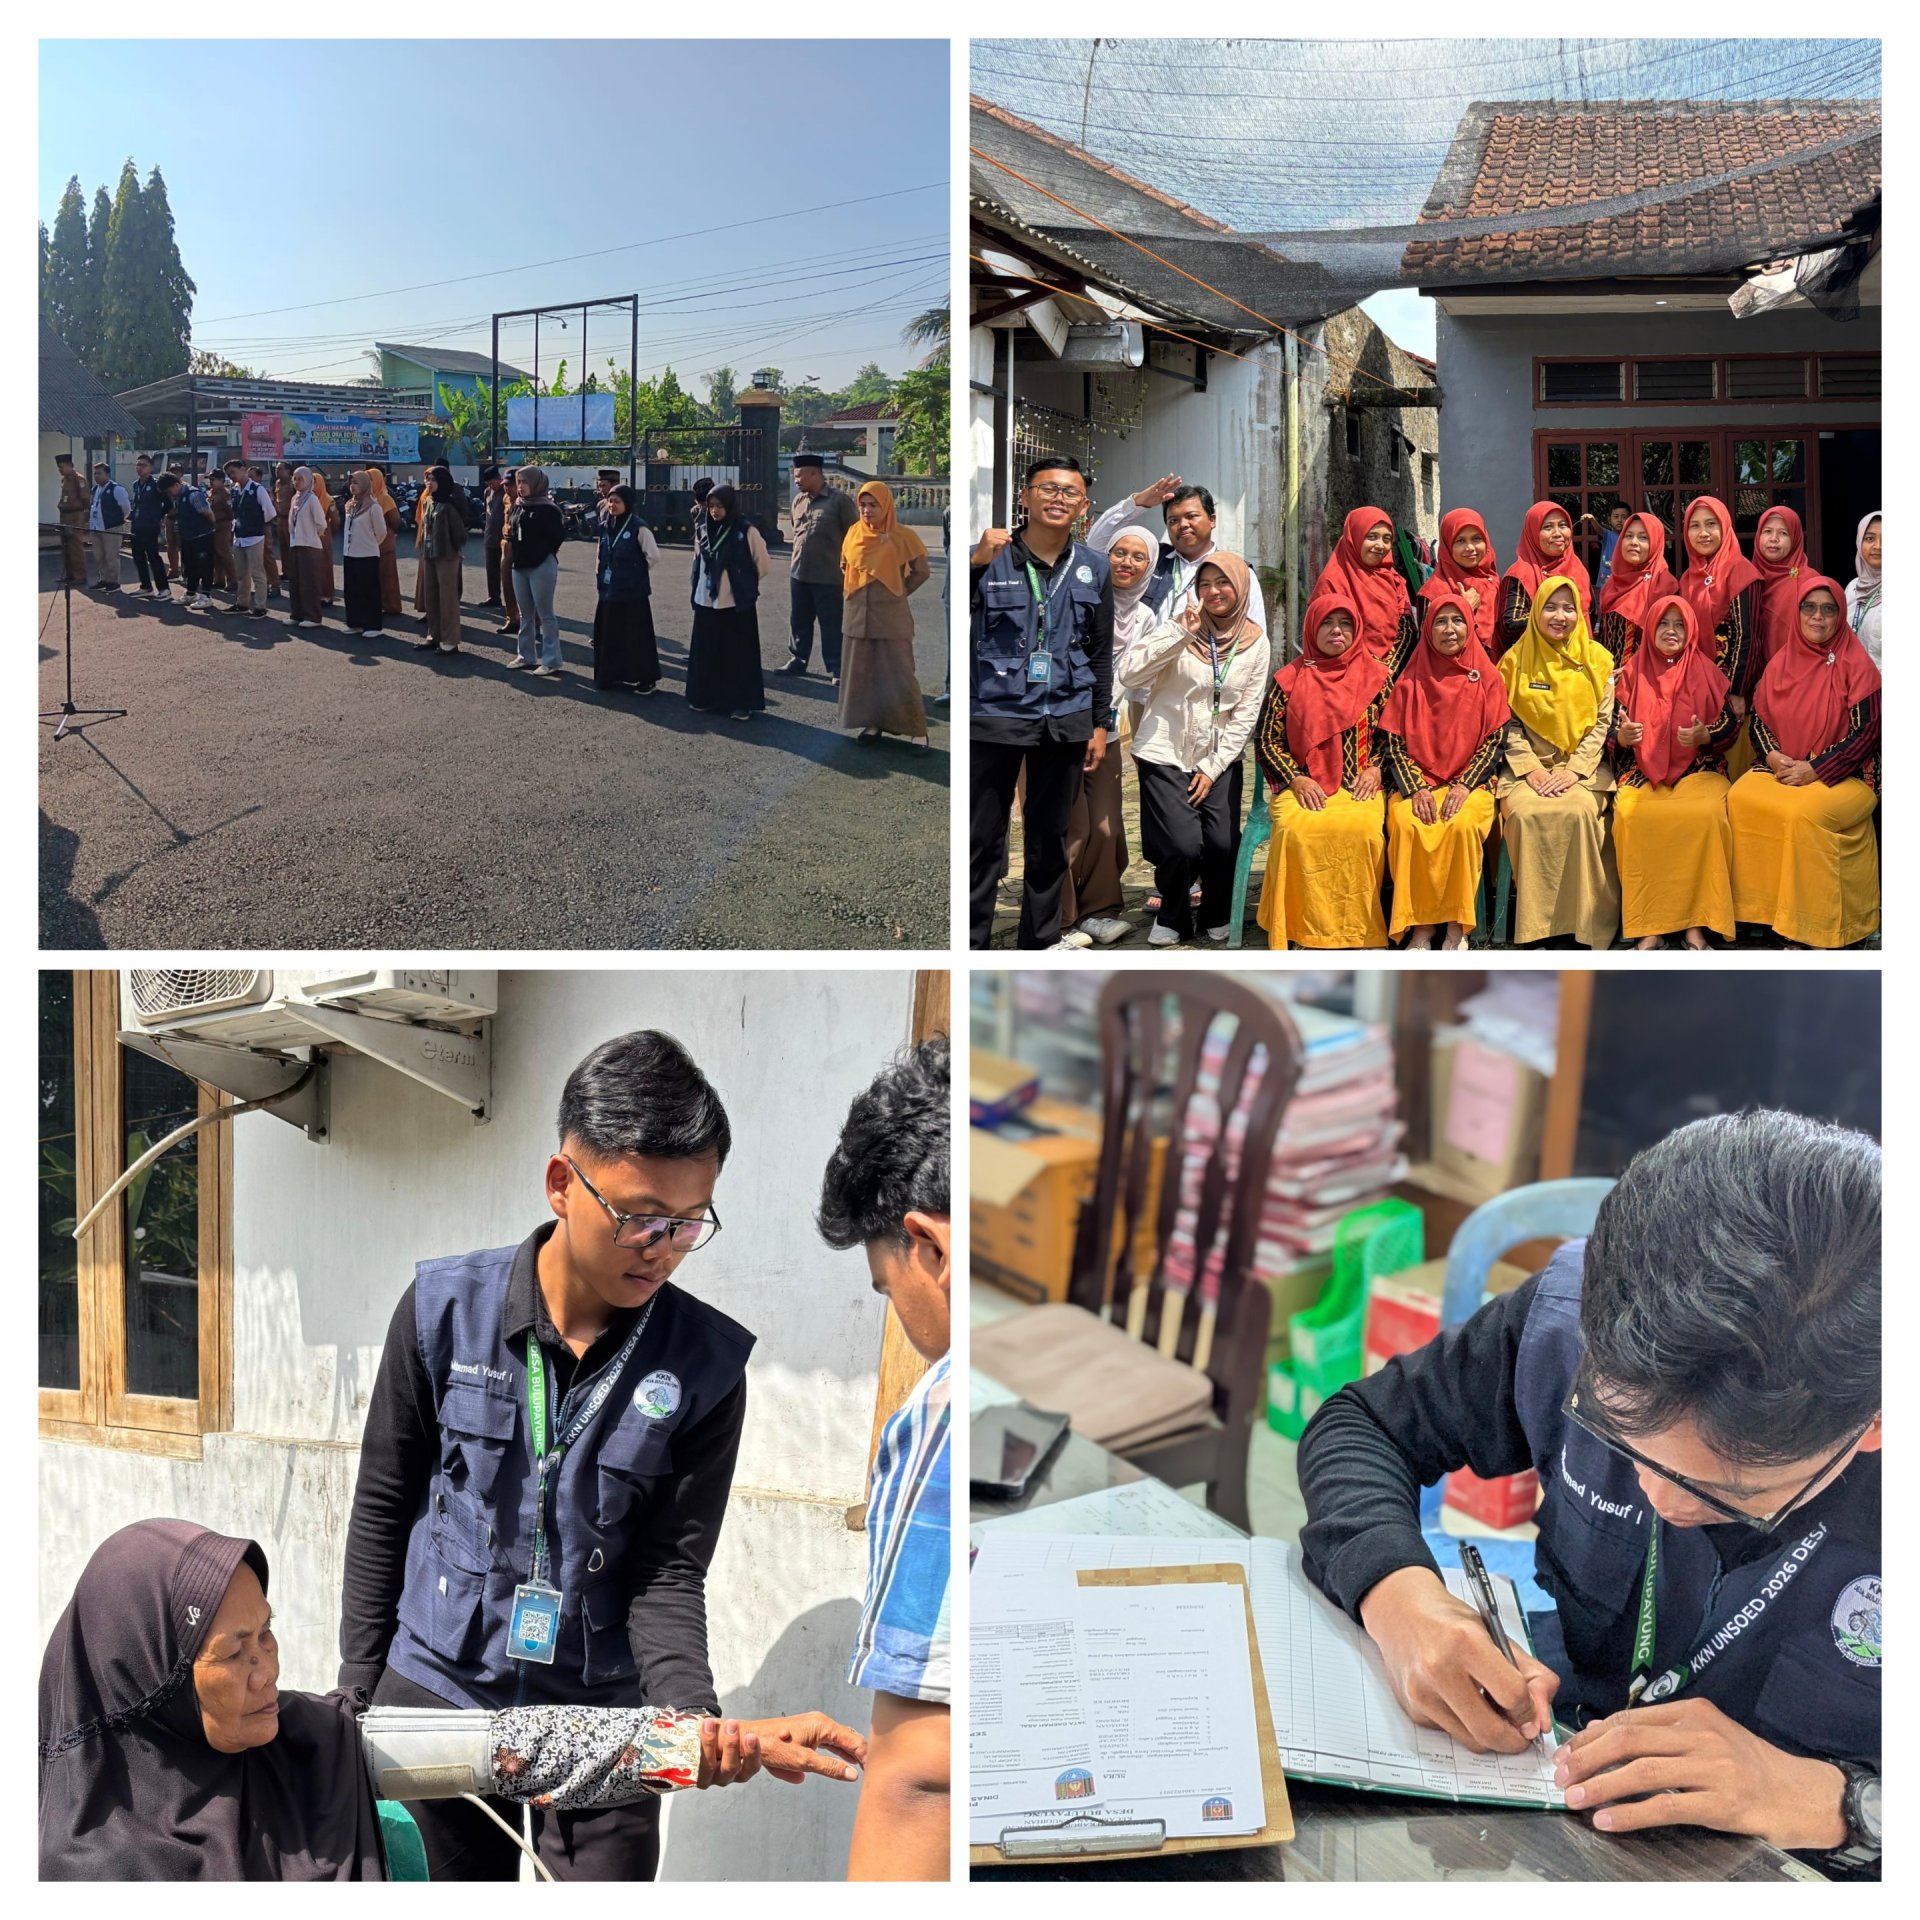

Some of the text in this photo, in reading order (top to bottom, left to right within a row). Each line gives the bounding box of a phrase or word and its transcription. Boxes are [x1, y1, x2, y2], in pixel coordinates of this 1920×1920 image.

[482, 1366, 506, 1381] Yusuf
[530, 1346, 543, 1375] DESA
[565, 1425, 584, 1446] KKN
[579, 1384, 611, 1423] UNSOED
[606, 1362, 624, 1387] 2026
[620, 1336, 639, 1363] DESA
[656, 1373, 672, 1382] KKN
[1591, 1490, 1634, 1519] Yusuf
[1690, 1643, 1716, 1673] KKN
[1711, 1598, 1766, 1651] UNSOED
[1761, 1561, 1798, 1600] 2026
[1024, 1808, 1134, 1818] DESA BULUPAYUNG
